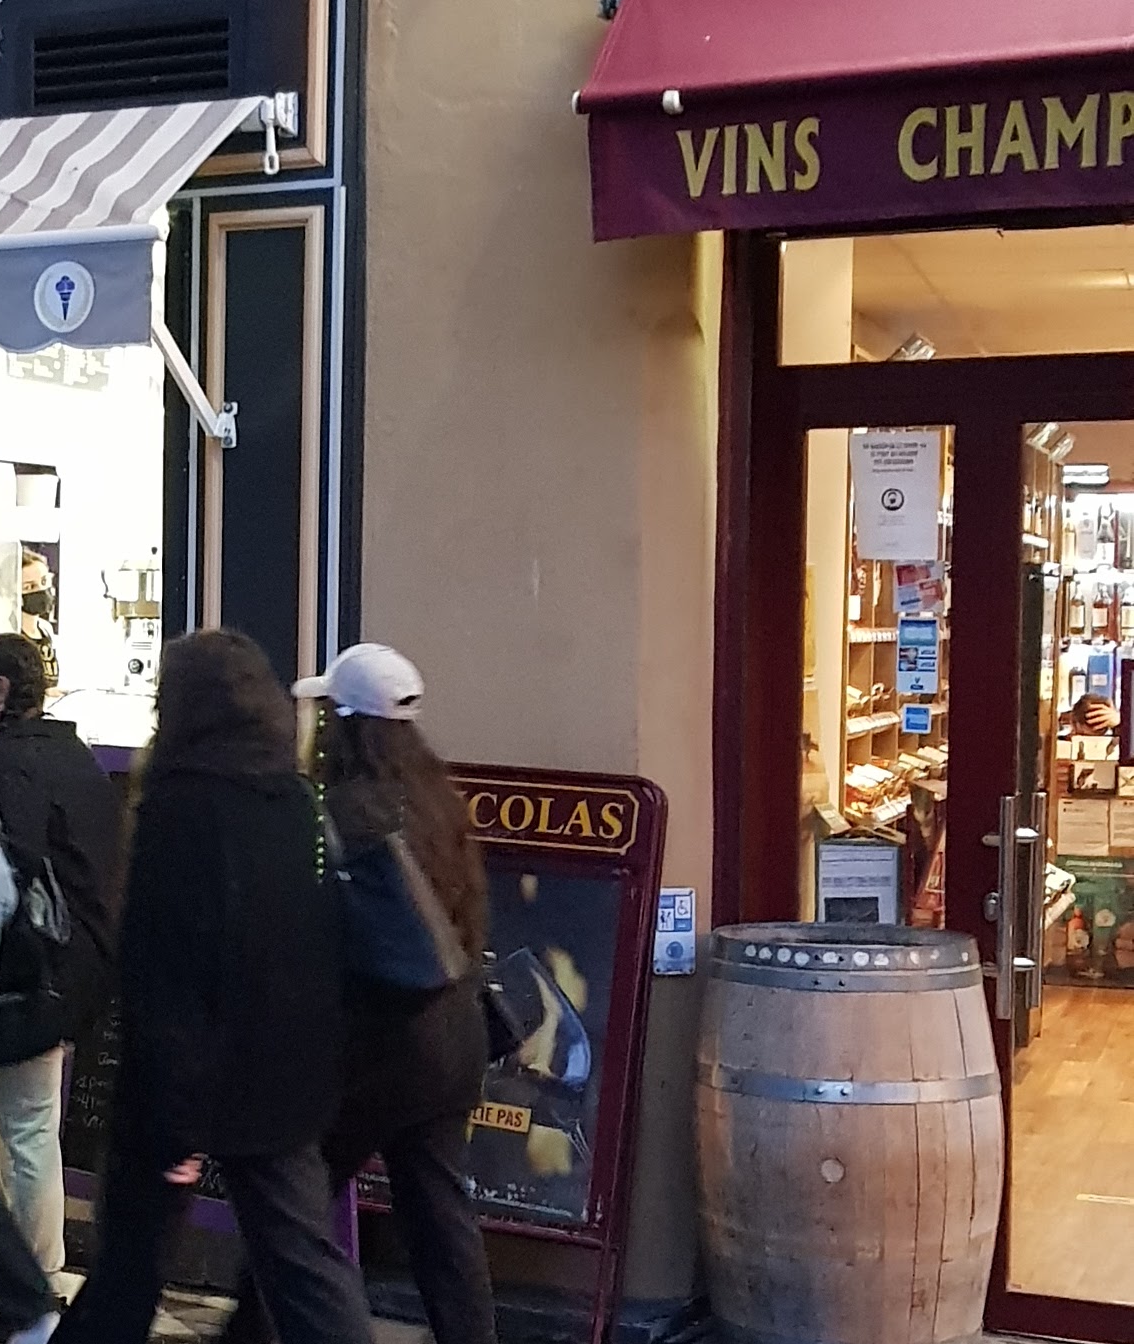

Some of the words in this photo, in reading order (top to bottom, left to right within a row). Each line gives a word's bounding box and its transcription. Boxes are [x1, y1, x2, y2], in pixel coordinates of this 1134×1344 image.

[676, 117, 822, 199] VINS
[468, 791, 625, 840] COLAS
[497, 1108, 524, 1128] PAS
